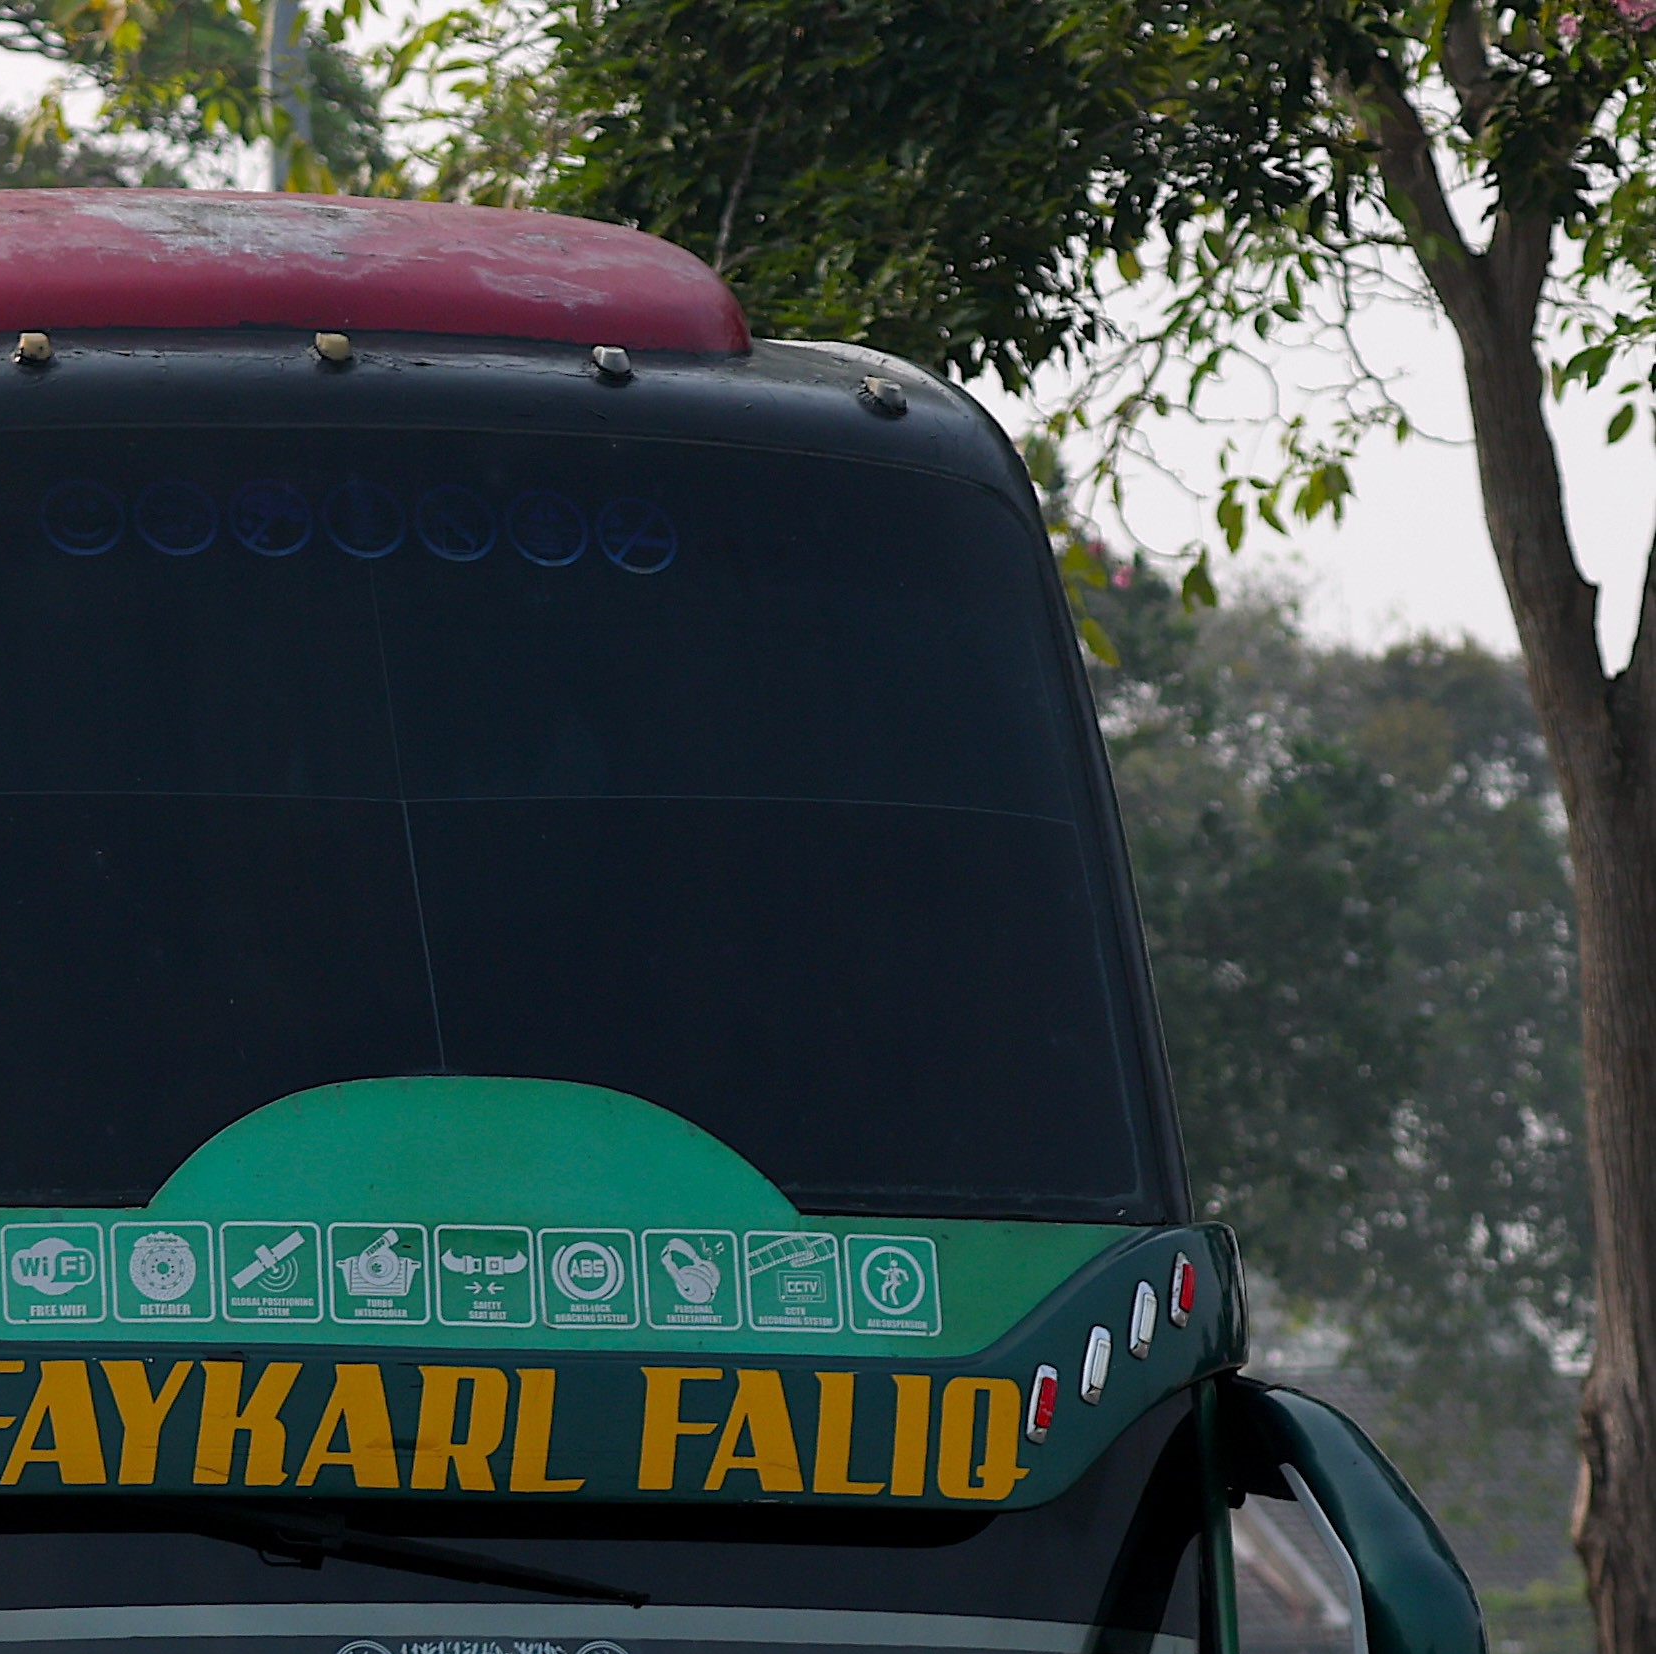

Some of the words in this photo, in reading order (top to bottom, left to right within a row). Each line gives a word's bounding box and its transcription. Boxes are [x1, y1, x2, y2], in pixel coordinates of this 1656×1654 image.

[570, 1258, 605, 1279] ABS
[787, 1280, 818, 1294] CCTV
[230, 1297, 260, 1307] GLOBAL
[262, 1297, 314, 1307] POSITIONING
[366, 1298, 393, 1307] TURBO
[30, 1304, 58, 1317] FREE
[59, 1304, 87, 1317] WIFI
[139, 1303, 191, 1316] RETADER
[257, 1306, 290, 1317] SYSTEM
[353, 1308, 408, 1318] INTERCOOLER
[469, 1309, 487, 1320] SEAT
[674, 1305, 713, 1314] PERSONAL
[597, 1313, 628, 1323] SYSTEM
[637, 1365, 1032, 1501] FALIQ
